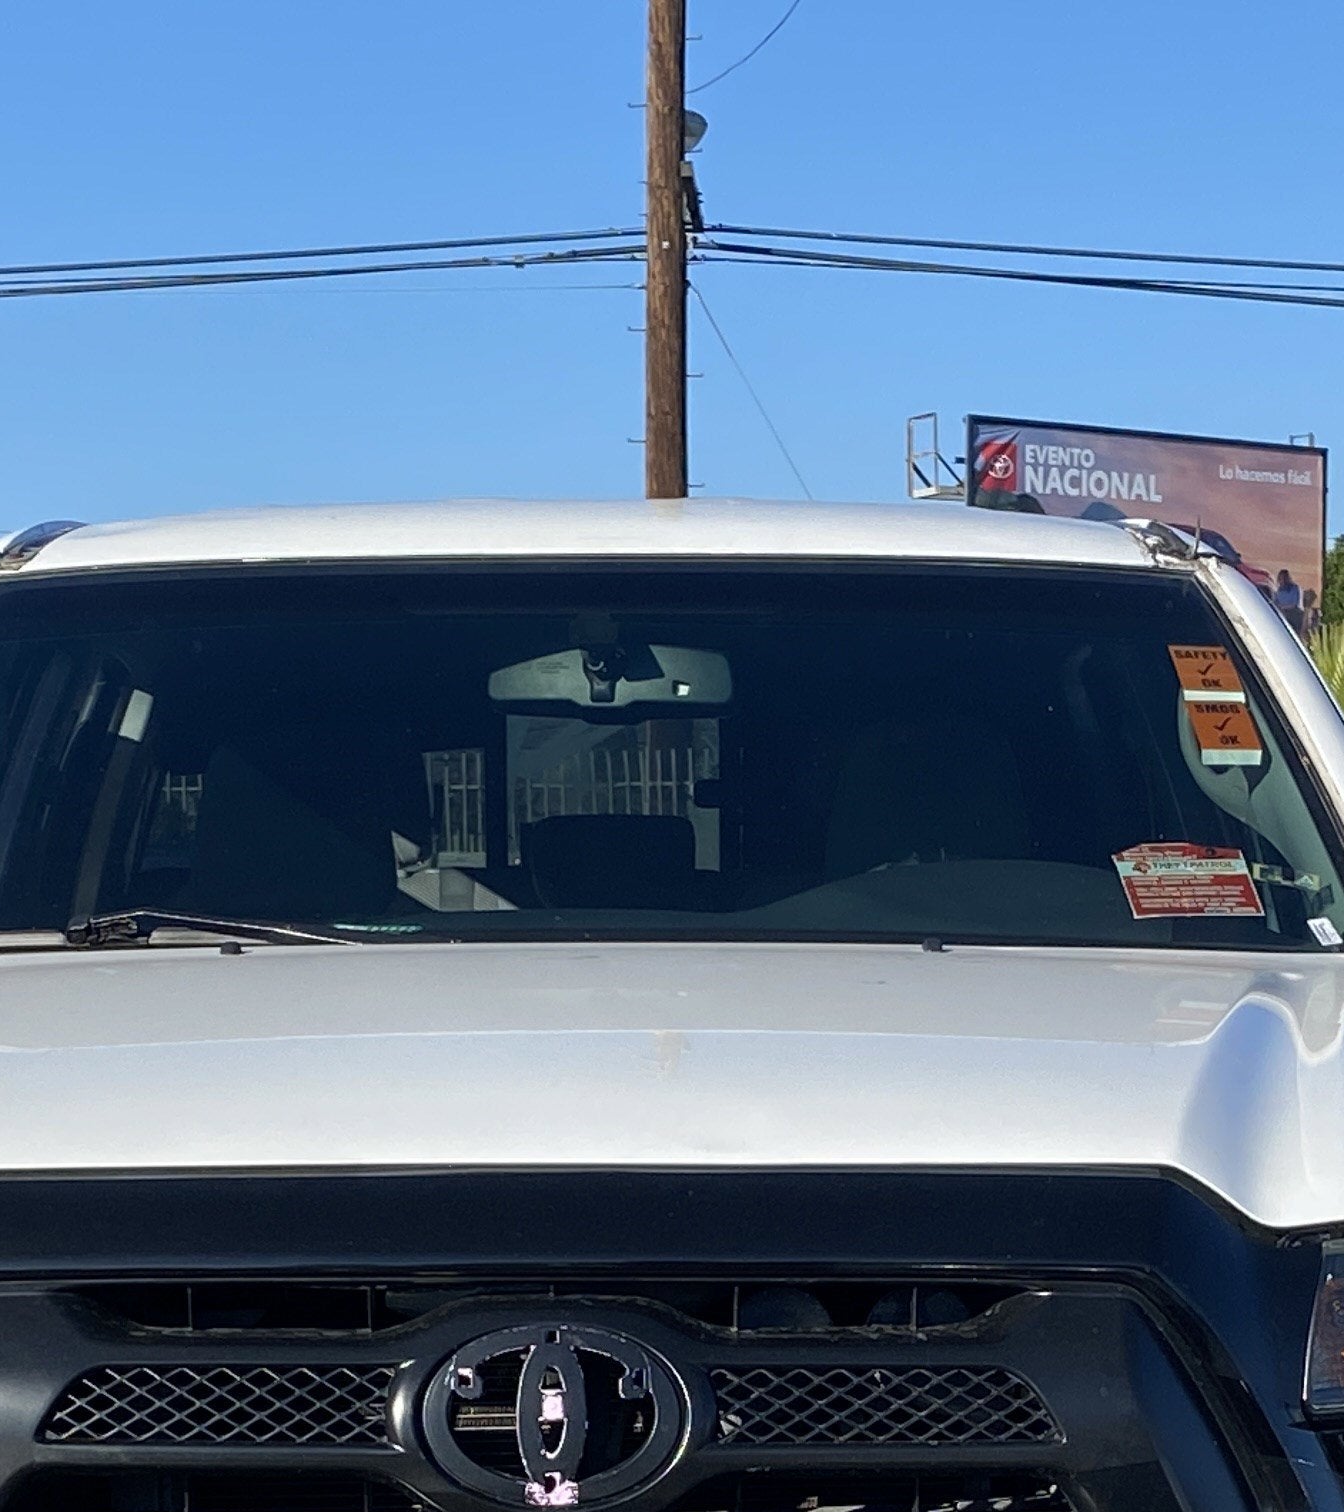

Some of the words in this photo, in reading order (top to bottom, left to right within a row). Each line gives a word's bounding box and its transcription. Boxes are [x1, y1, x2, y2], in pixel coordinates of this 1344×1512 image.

[1025, 444, 1095, 469] EVENTO
[1219, 464, 1234, 479] Lo
[1235, 465, 1286, 484] hacemos
[1024, 465, 1163, 502] NACIONAL
[1174, 650, 1227, 660] SAFETY
[1201, 678, 1222, 688] OK
[1194, 704, 1241, 714] SMOG
[1220, 735, 1241, 745] OK
